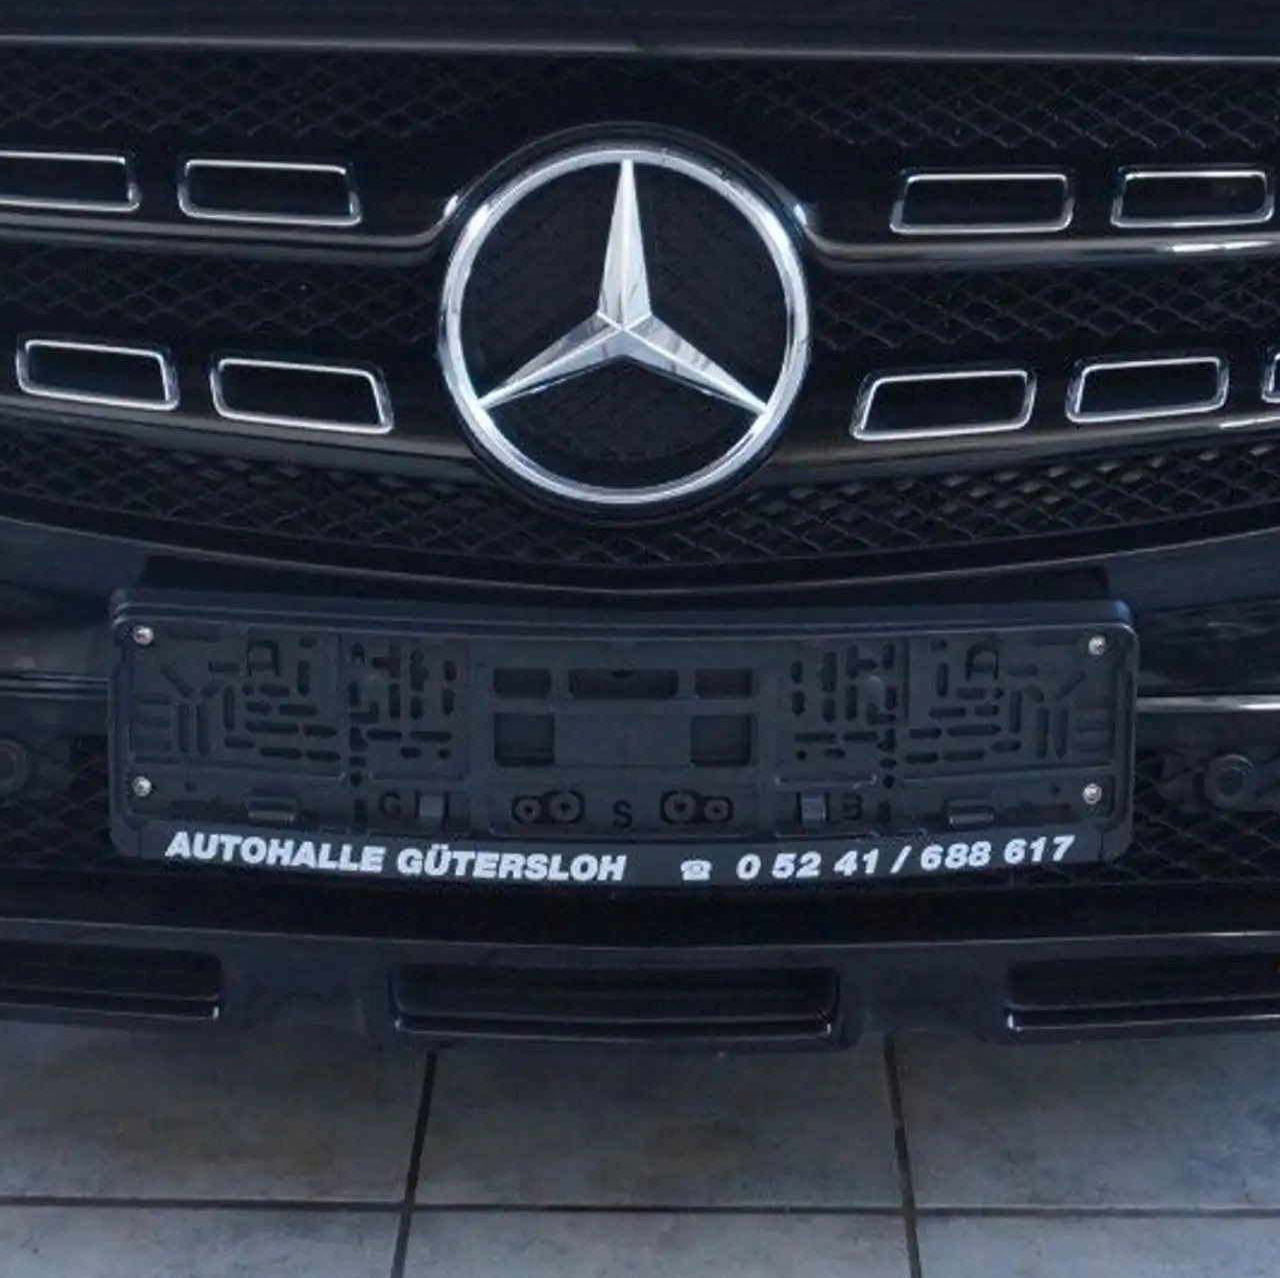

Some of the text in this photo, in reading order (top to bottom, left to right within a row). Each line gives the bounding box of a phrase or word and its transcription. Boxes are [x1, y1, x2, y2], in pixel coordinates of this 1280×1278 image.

[164, 831, 387, 873] AUTOHALLE
[396, 843, 627, 882] GÜTERSLOH
[736, 853, 762, 881] 0
[771, 851, 822, 879] 52
[833, 848, 879, 877] 41
[920, 840, 992, 871] 688
[1003, 834, 1075, 865] 617
